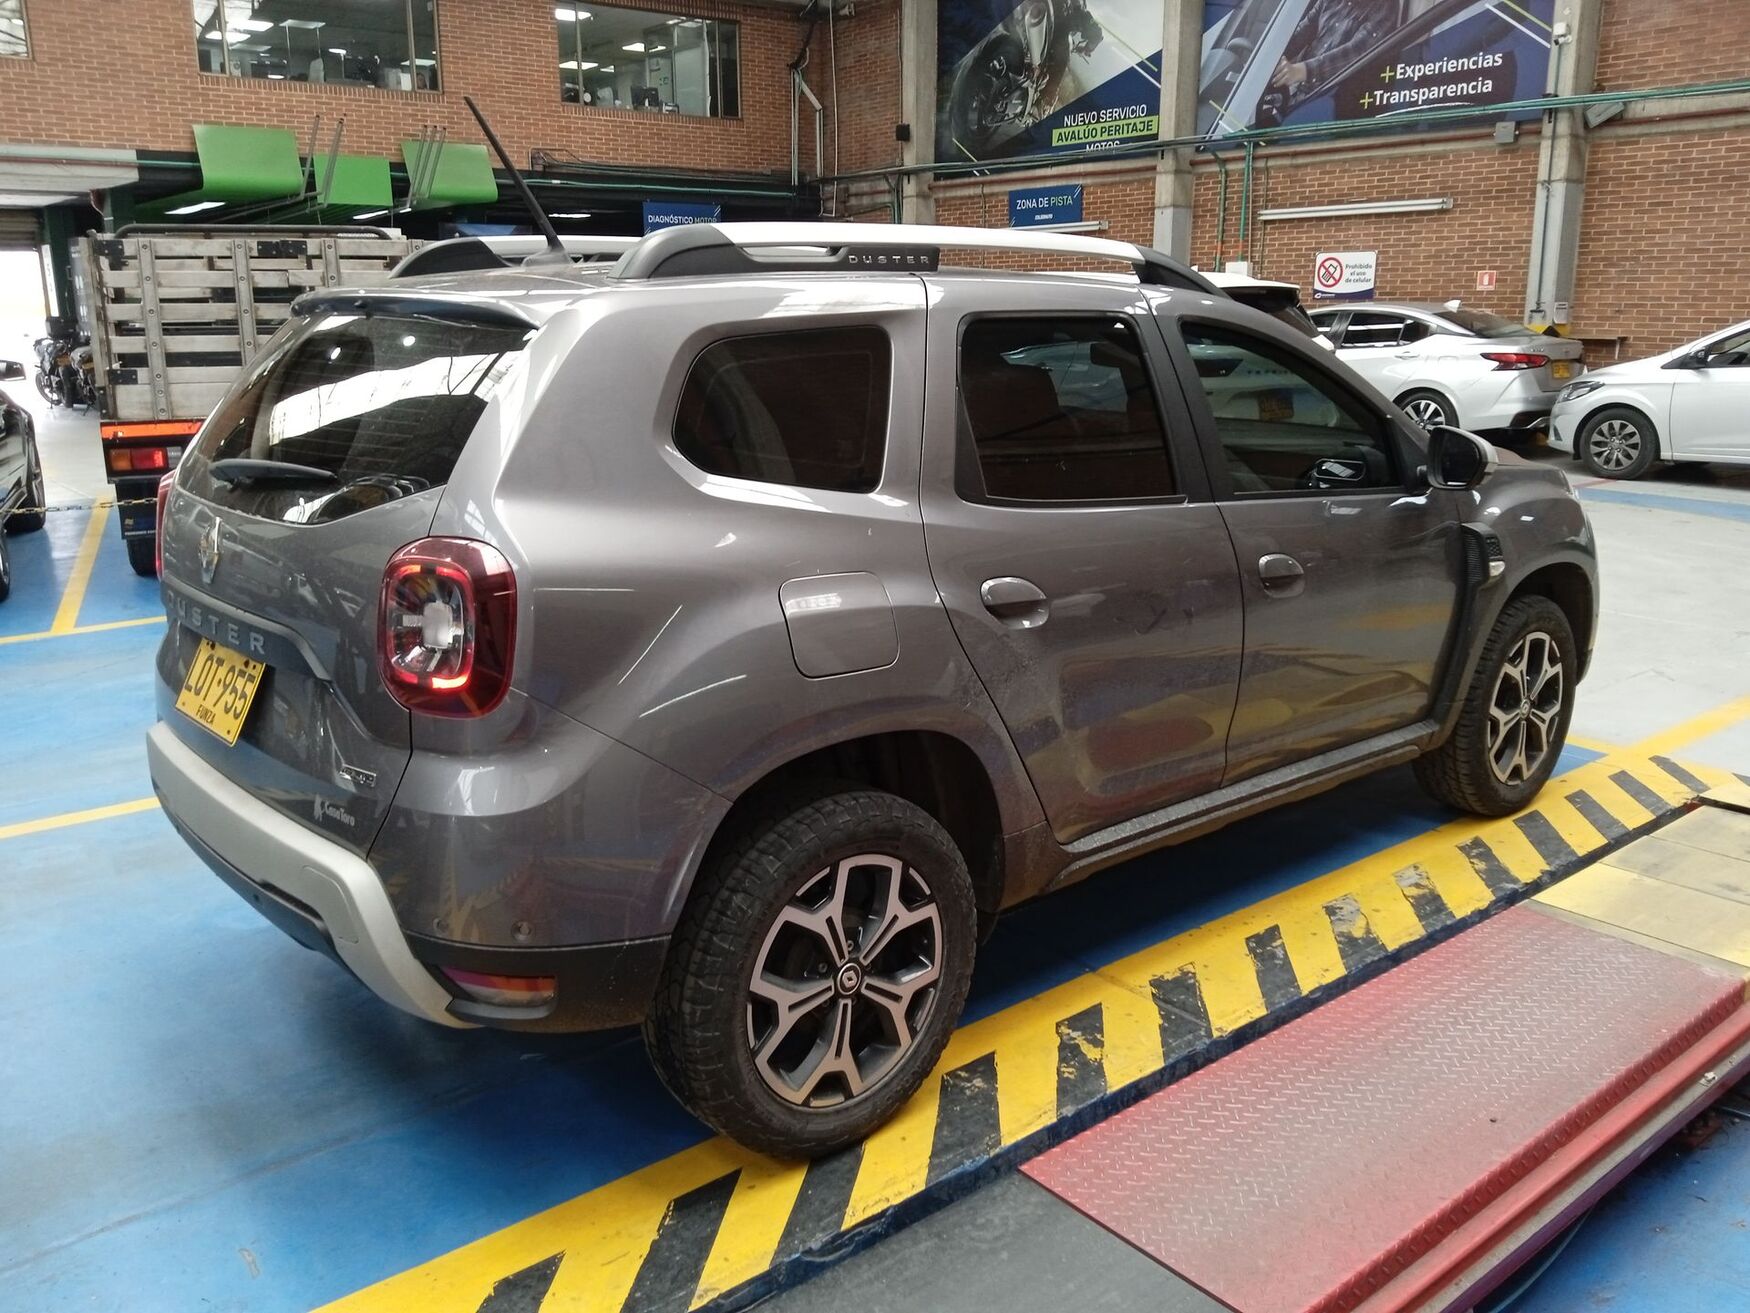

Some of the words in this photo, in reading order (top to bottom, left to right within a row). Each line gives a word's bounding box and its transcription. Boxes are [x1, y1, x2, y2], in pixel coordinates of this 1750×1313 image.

[1063, 111, 1098, 127] NUEVO
[1099, 104, 1147, 122] SERVICIO
[1056, 126, 1098, 143] AVALÚO
[1100, 119, 1154, 137] PERITAJE
[1016, 199, 1037, 210] ZONA
[1038, 197, 1049, 208] DE
[1050, 195, 1073, 207] PISTA
[648, 214, 694, 224] DIAGNÓSTICO
[848, 255, 929, 264] DUSTER
[167, 590, 265, 655] DUSTER
[195, 703, 217, 725] FUNZA
